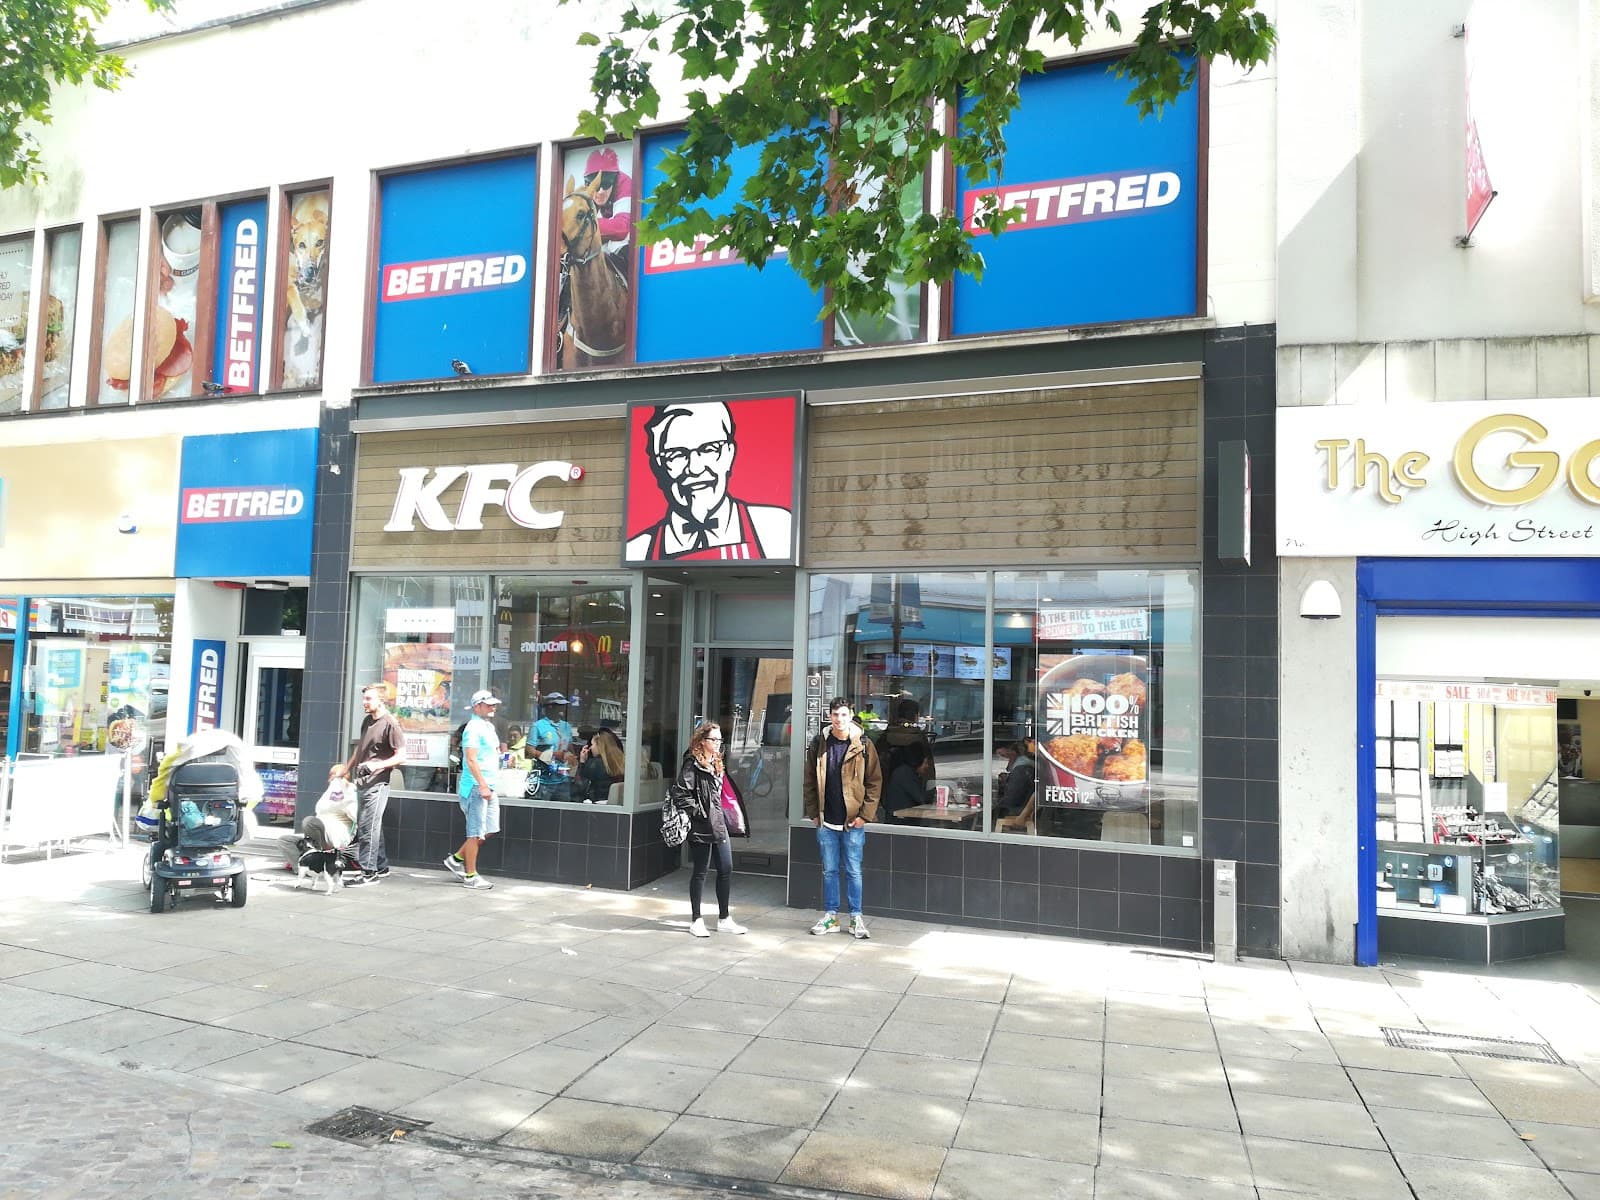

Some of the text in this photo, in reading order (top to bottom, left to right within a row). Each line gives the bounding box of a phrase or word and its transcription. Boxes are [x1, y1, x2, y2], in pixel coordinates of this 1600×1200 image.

[971, 171, 1181, 229] BETFRED
[386, 254, 528, 297] BETFRED
[228, 218, 258, 388] BETFRED
[1315, 438, 1430, 504] The
[186, 489, 304, 519] BETFRED
[384, 460, 572, 532] KFC
[1421, 519, 1594, 546] High Street
[1049, 611, 1066, 622] THE
[1082, 623, 1095, 633] TO
[1098, 620, 1118, 632] THE
[1120, 617, 1143, 629] RICE
[196, 648, 219, 731] TFRED
[1445, 685, 1470, 699] SALE
[1071, 693, 1140, 715] 100%
[1071, 713, 1139, 729] BRITISH
[1071, 727, 1139, 739] CHICKEN
[1045, 789, 1079, 803] FEAST
